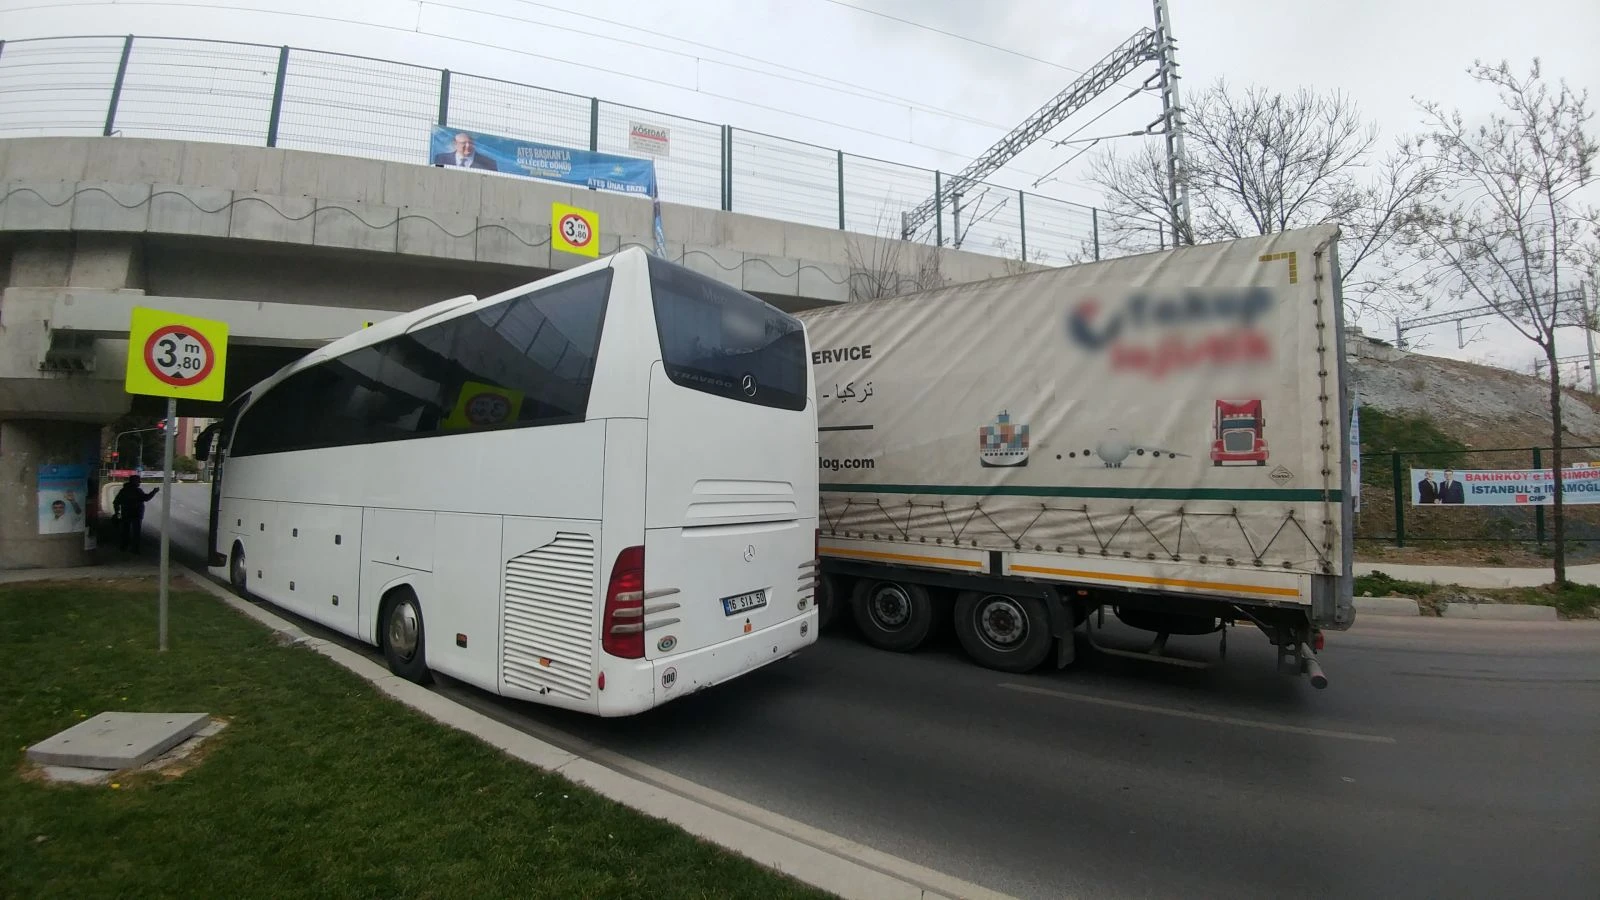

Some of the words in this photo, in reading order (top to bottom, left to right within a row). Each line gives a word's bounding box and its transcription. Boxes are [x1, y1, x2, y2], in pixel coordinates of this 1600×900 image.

[588, 177, 606, 189] ATEŞ
[565, 220, 575, 237] 3
[157, 339, 177, 368] 3
[184, 343, 200, 354] m
[812, 344, 872, 365] ERVICE
[835, 381, 874, 403] تركيا
[819, 456, 875, 471] log.com
[729, 599, 737, 610] 16
[663, 672, 675, 685] 100
